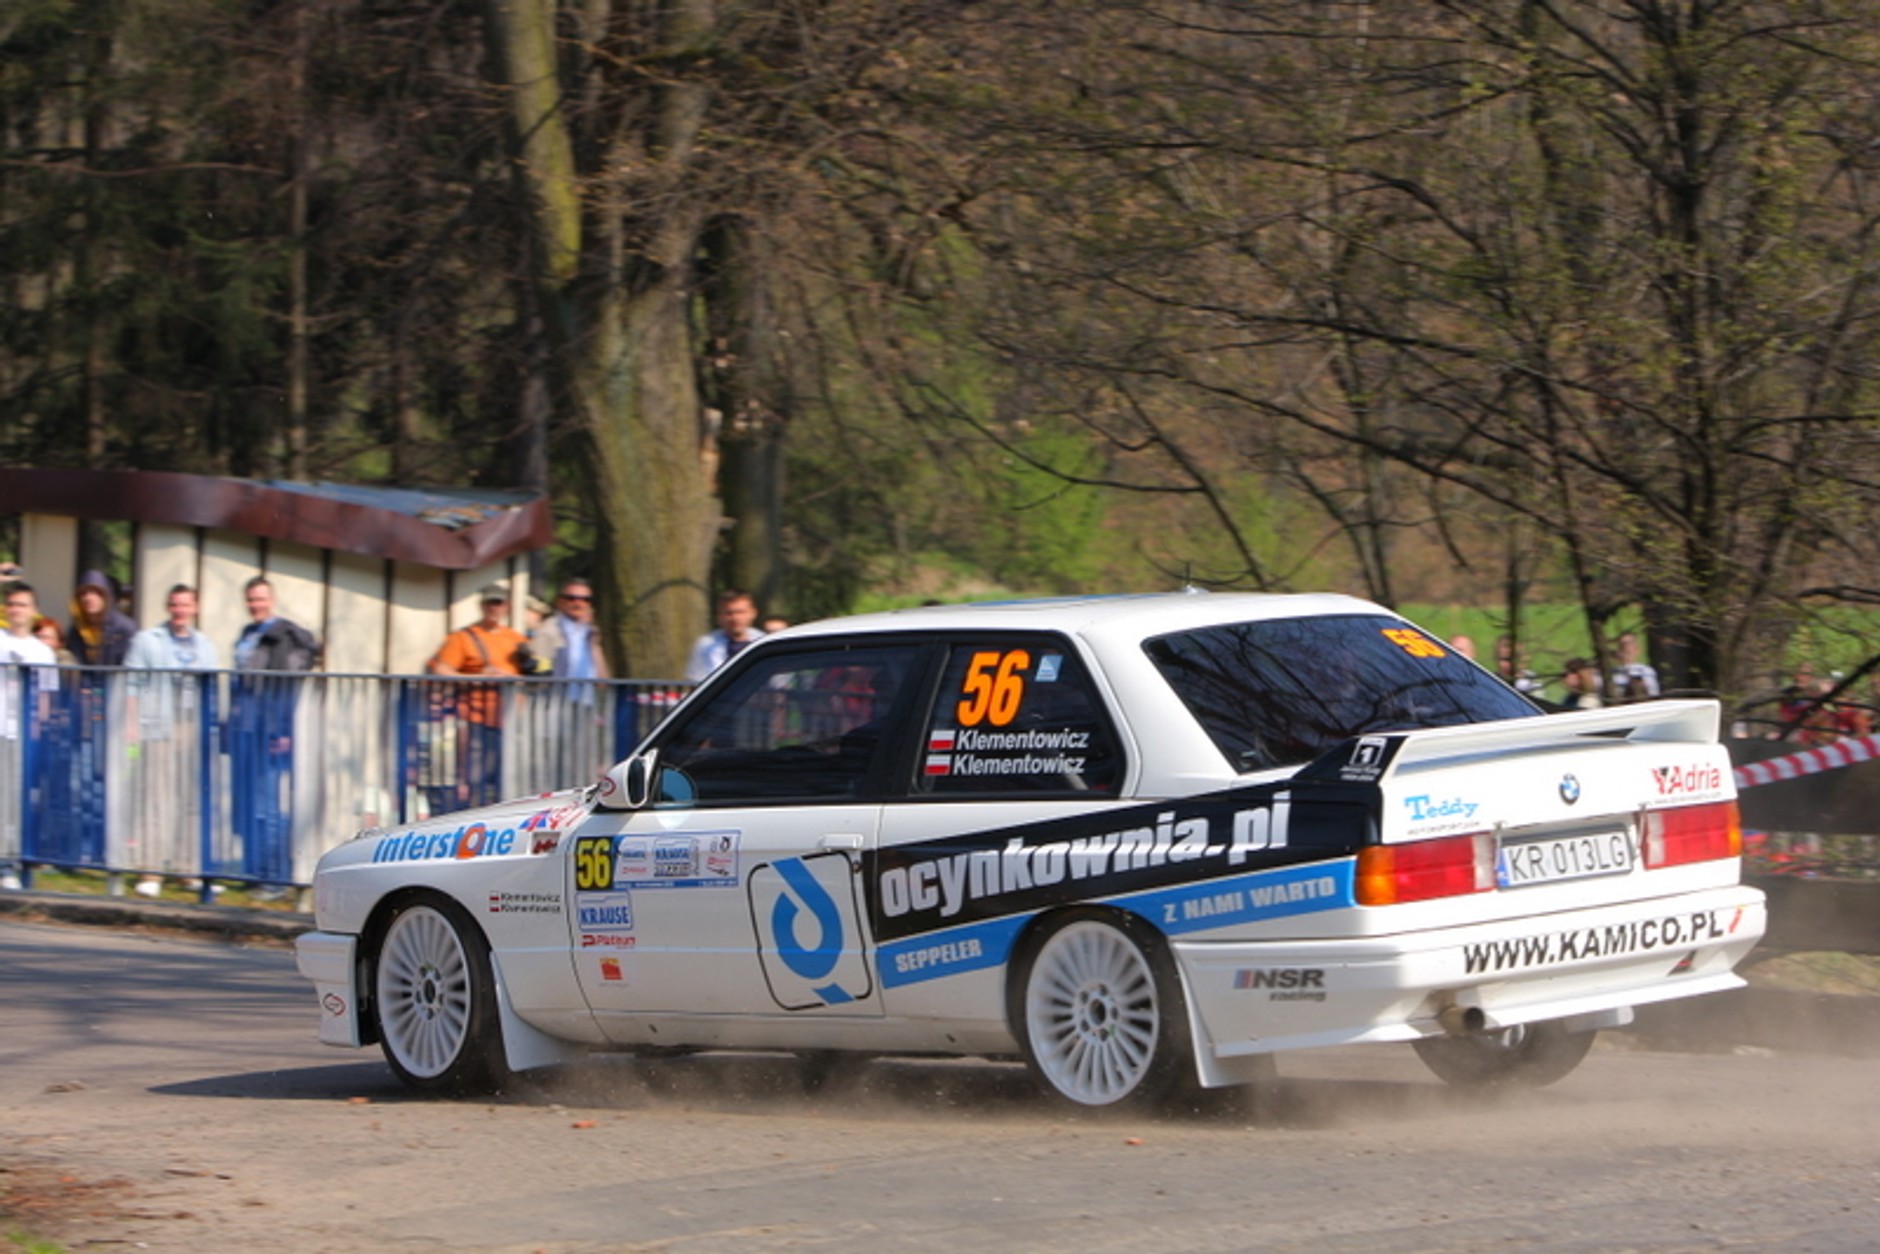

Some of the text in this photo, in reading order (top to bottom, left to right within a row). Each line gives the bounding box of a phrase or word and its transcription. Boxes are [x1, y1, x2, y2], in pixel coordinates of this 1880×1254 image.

[1380, 628, 1446, 658] 56
[957, 650, 1031, 727] 56
[957, 728, 1090, 750] Klementowicz
[953, 752, 1085, 775] Klementowicz
[1668, 763, 1721, 794] Adria
[1404, 794, 1479, 821] Teddy
[577, 838, 611, 888] 56
[880, 790, 1292, 918] ocynkownia.pl
[1509, 835, 1625, 881] KR 013LG
[580, 906, 629, 925] KRAUSE
[1162, 876, 1337, 924] Z NAMI WARTO
[895, 939, 983, 974] SEPPELER
[1463, 910, 1724, 974] WWW.KAMICO.PL
[1251, 969, 1325, 989] NSR
